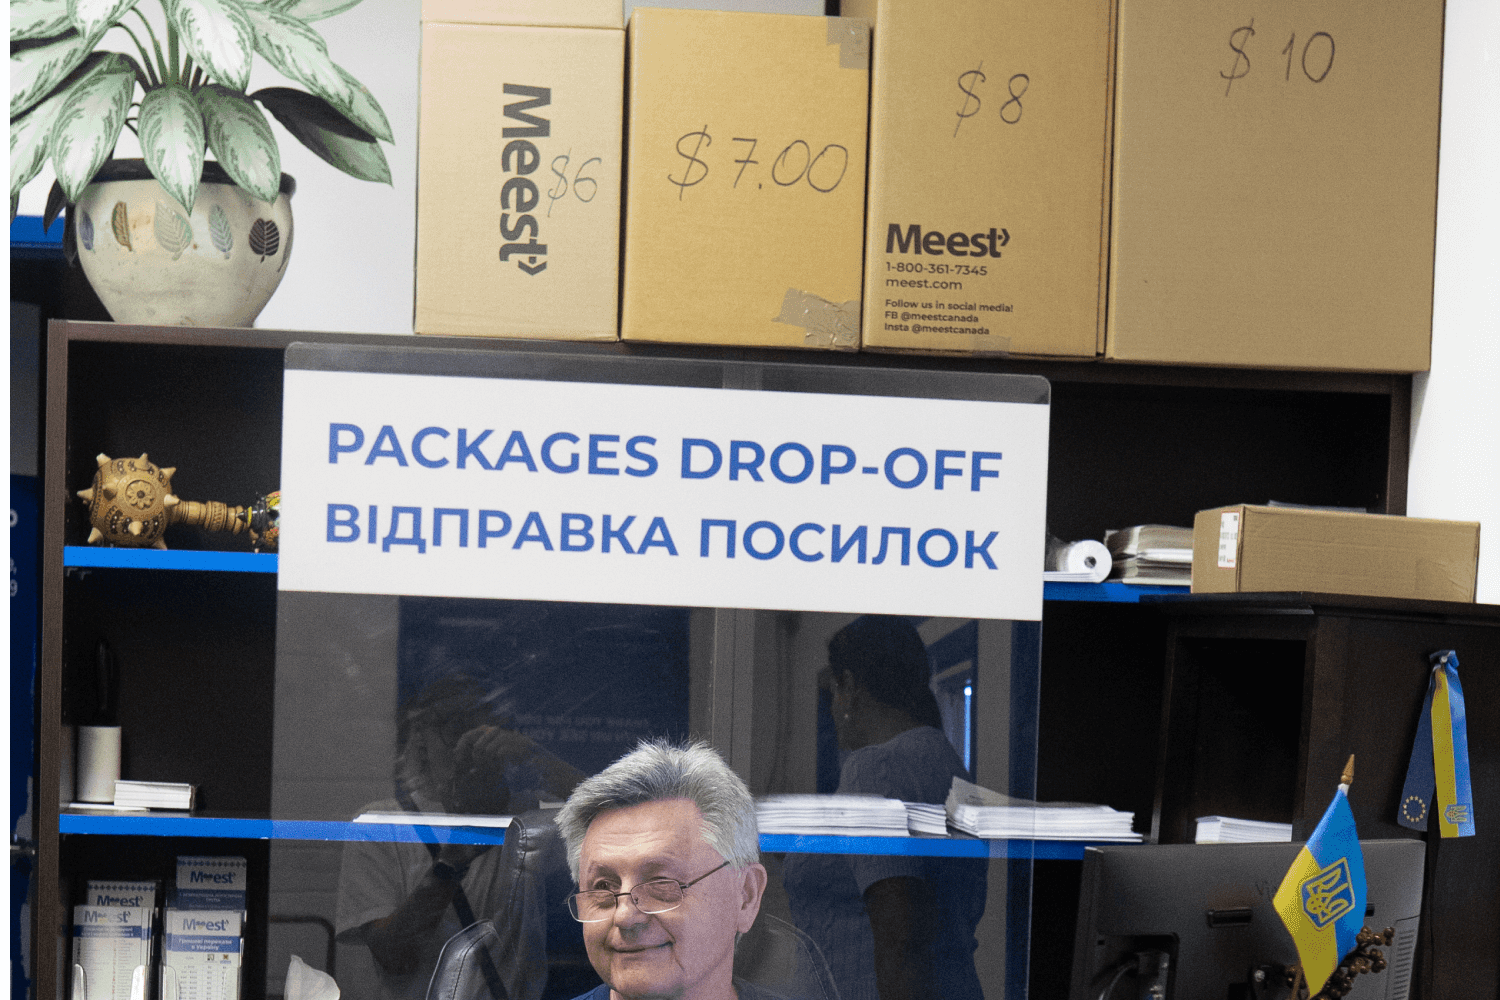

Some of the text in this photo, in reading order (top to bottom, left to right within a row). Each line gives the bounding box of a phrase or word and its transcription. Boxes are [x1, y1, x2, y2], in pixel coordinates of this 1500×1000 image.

[1220, 18, 1335, 97] $ 10
[954, 61, 1029, 138] $ 8
[499, 83, 551, 262] Meest
[548, 147, 602, 217] $6
[732, 137, 849, 193] 7.00
[886, 224, 1002, 258] Meest
[886, 262, 988, 276] 1-800-361-7345
[886, 278, 963, 290] meest.com
[884, 311, 979, 323] FB @meestcanada
[885, 299, 919, 309] Follow
[935, 300, 945, 310] in
[947, 302, 977, 312] social
[978, 304, 1014, 313] media!
[884, 323, 990, 335] Insta @meestcanada
[327, 422, 1003, 493] PACKAGES DROP-OFF
[325, 503, 1000, 571] ВІДПРАВКА ПОСИЛОК
[84, 911, 129, 923] Mst
